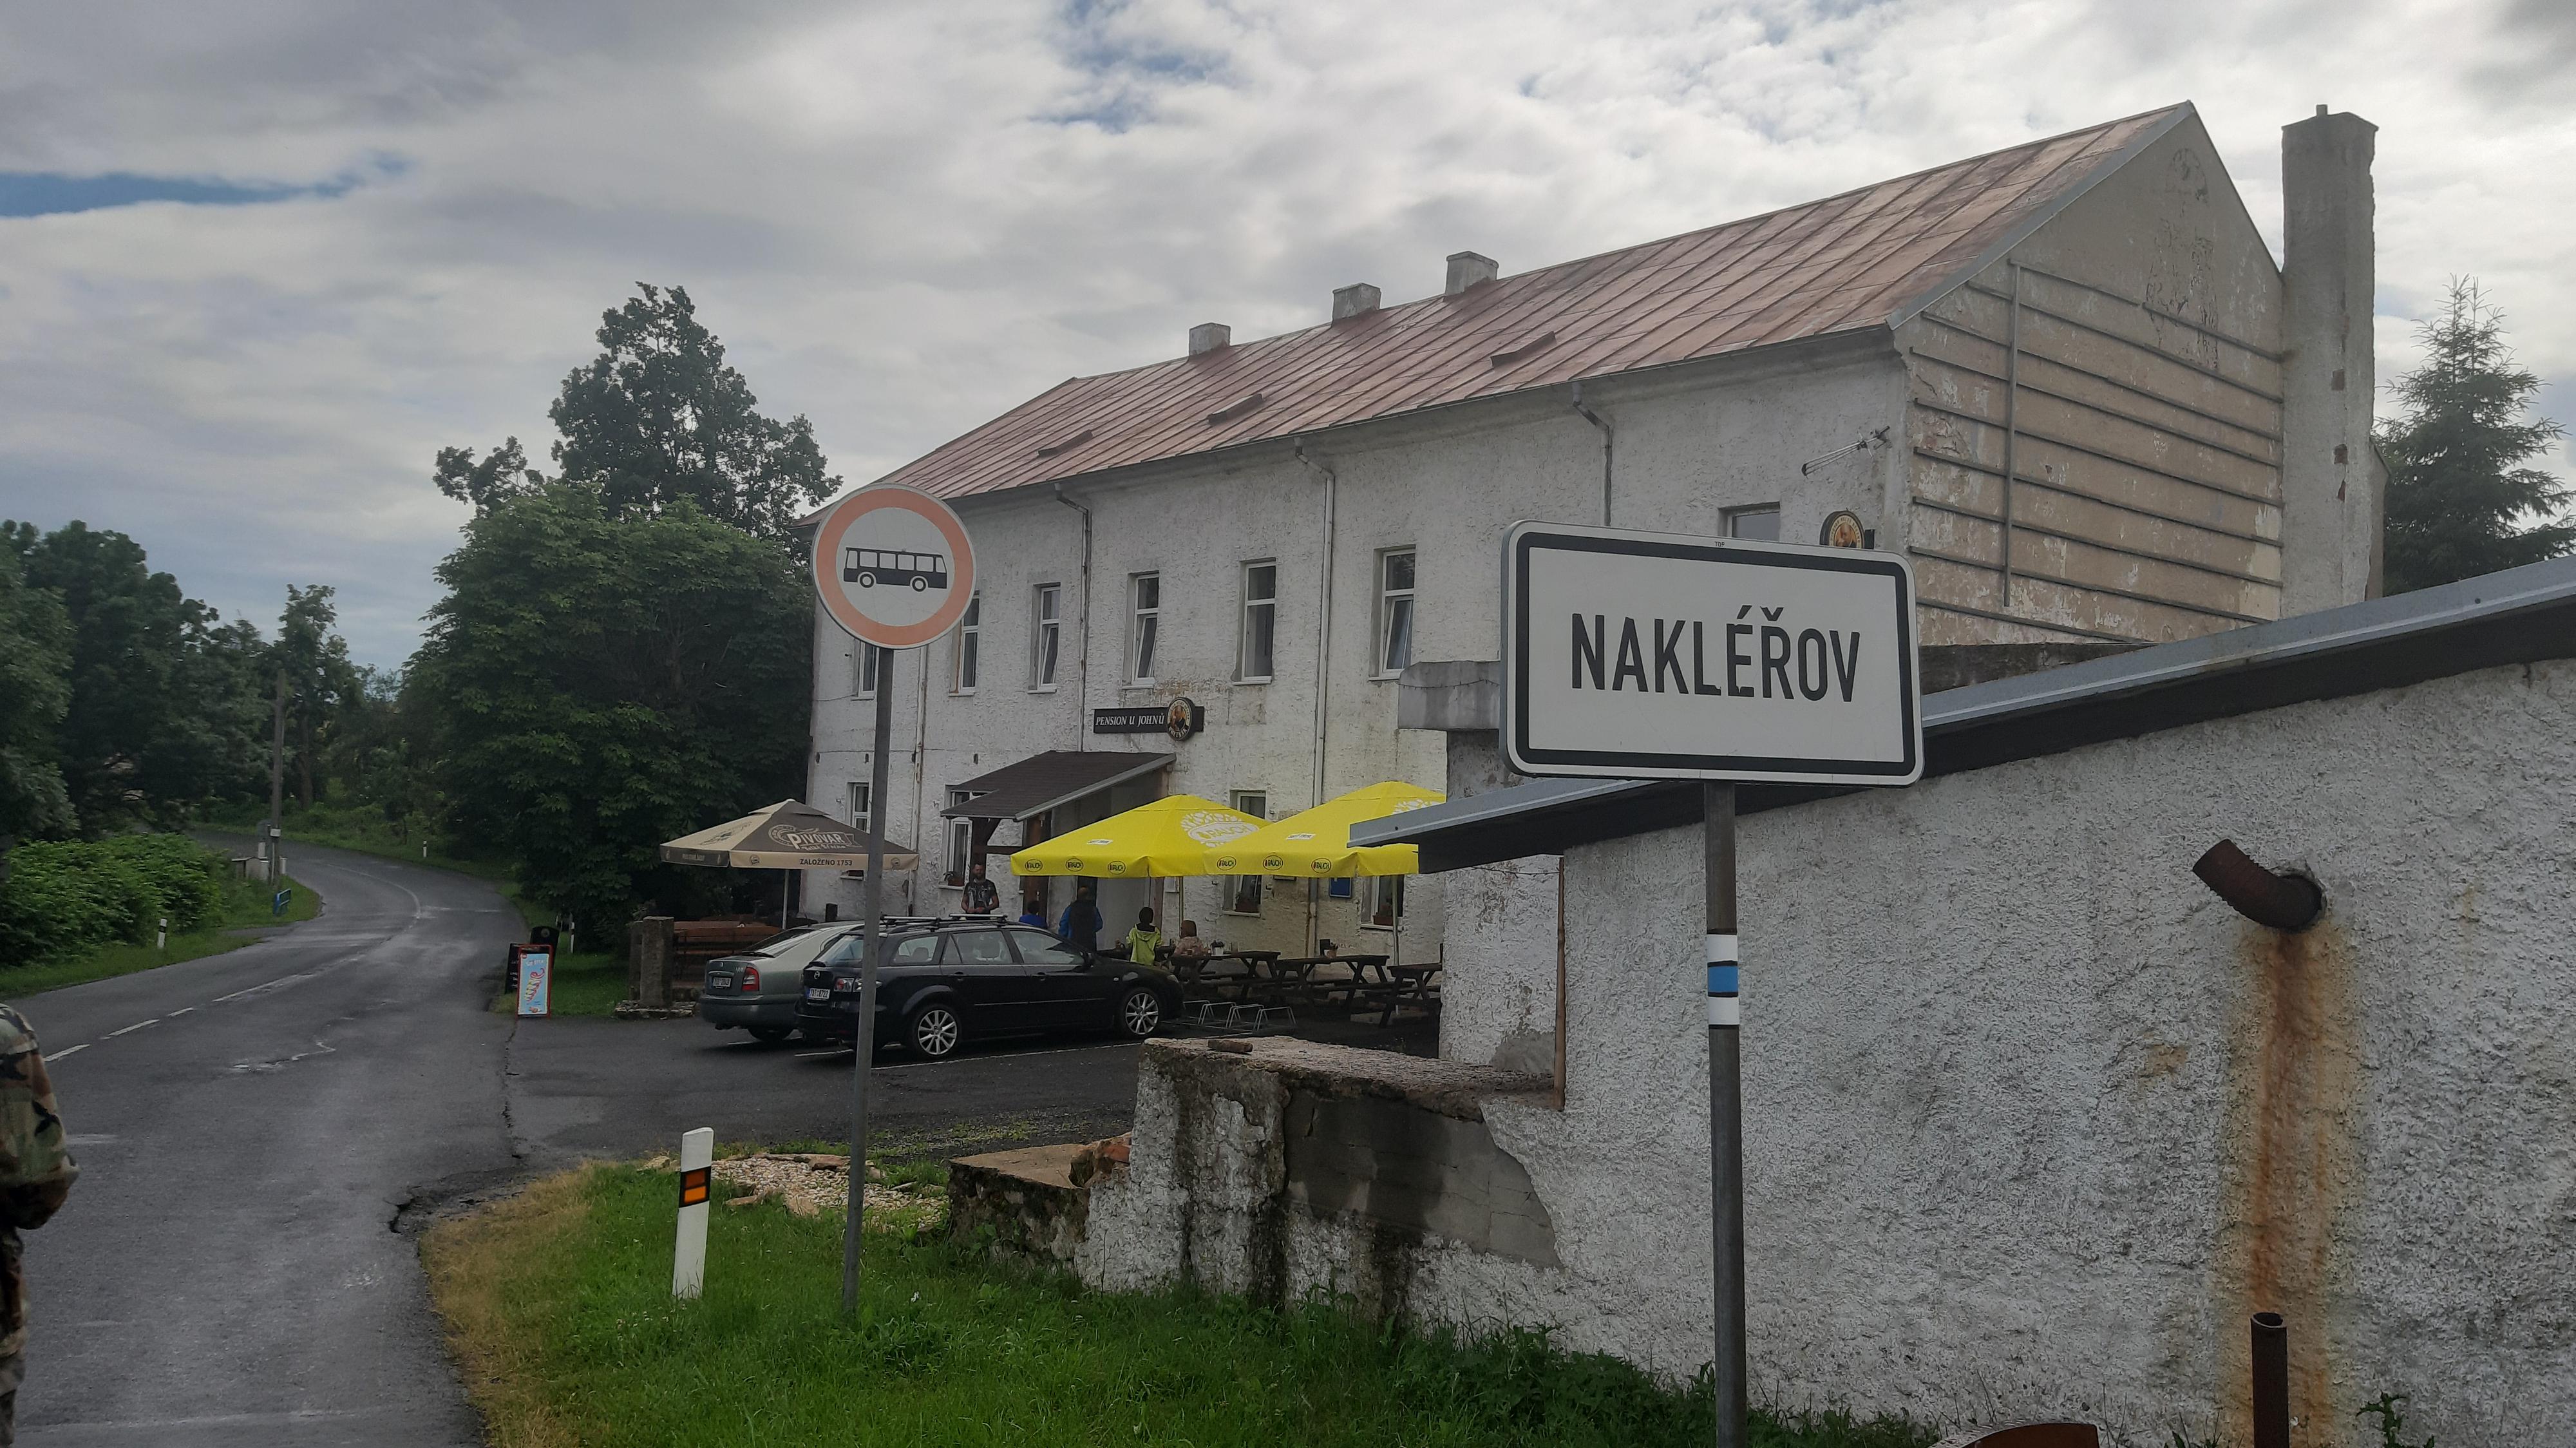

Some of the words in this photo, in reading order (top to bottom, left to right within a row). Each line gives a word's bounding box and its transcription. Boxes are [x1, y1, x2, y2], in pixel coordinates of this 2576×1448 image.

[1571, 605, 1860, 702] NAKLÉŘOV
[1095, 716, 1127, 726] PENSION
[1129, 716, 1135, 725] U
[1137, 712, 1165, 727] JOHNŮ
[787, 833, 846, 850] PIVOVAR
[800, 857, 835, 866] ZALOŽENO
